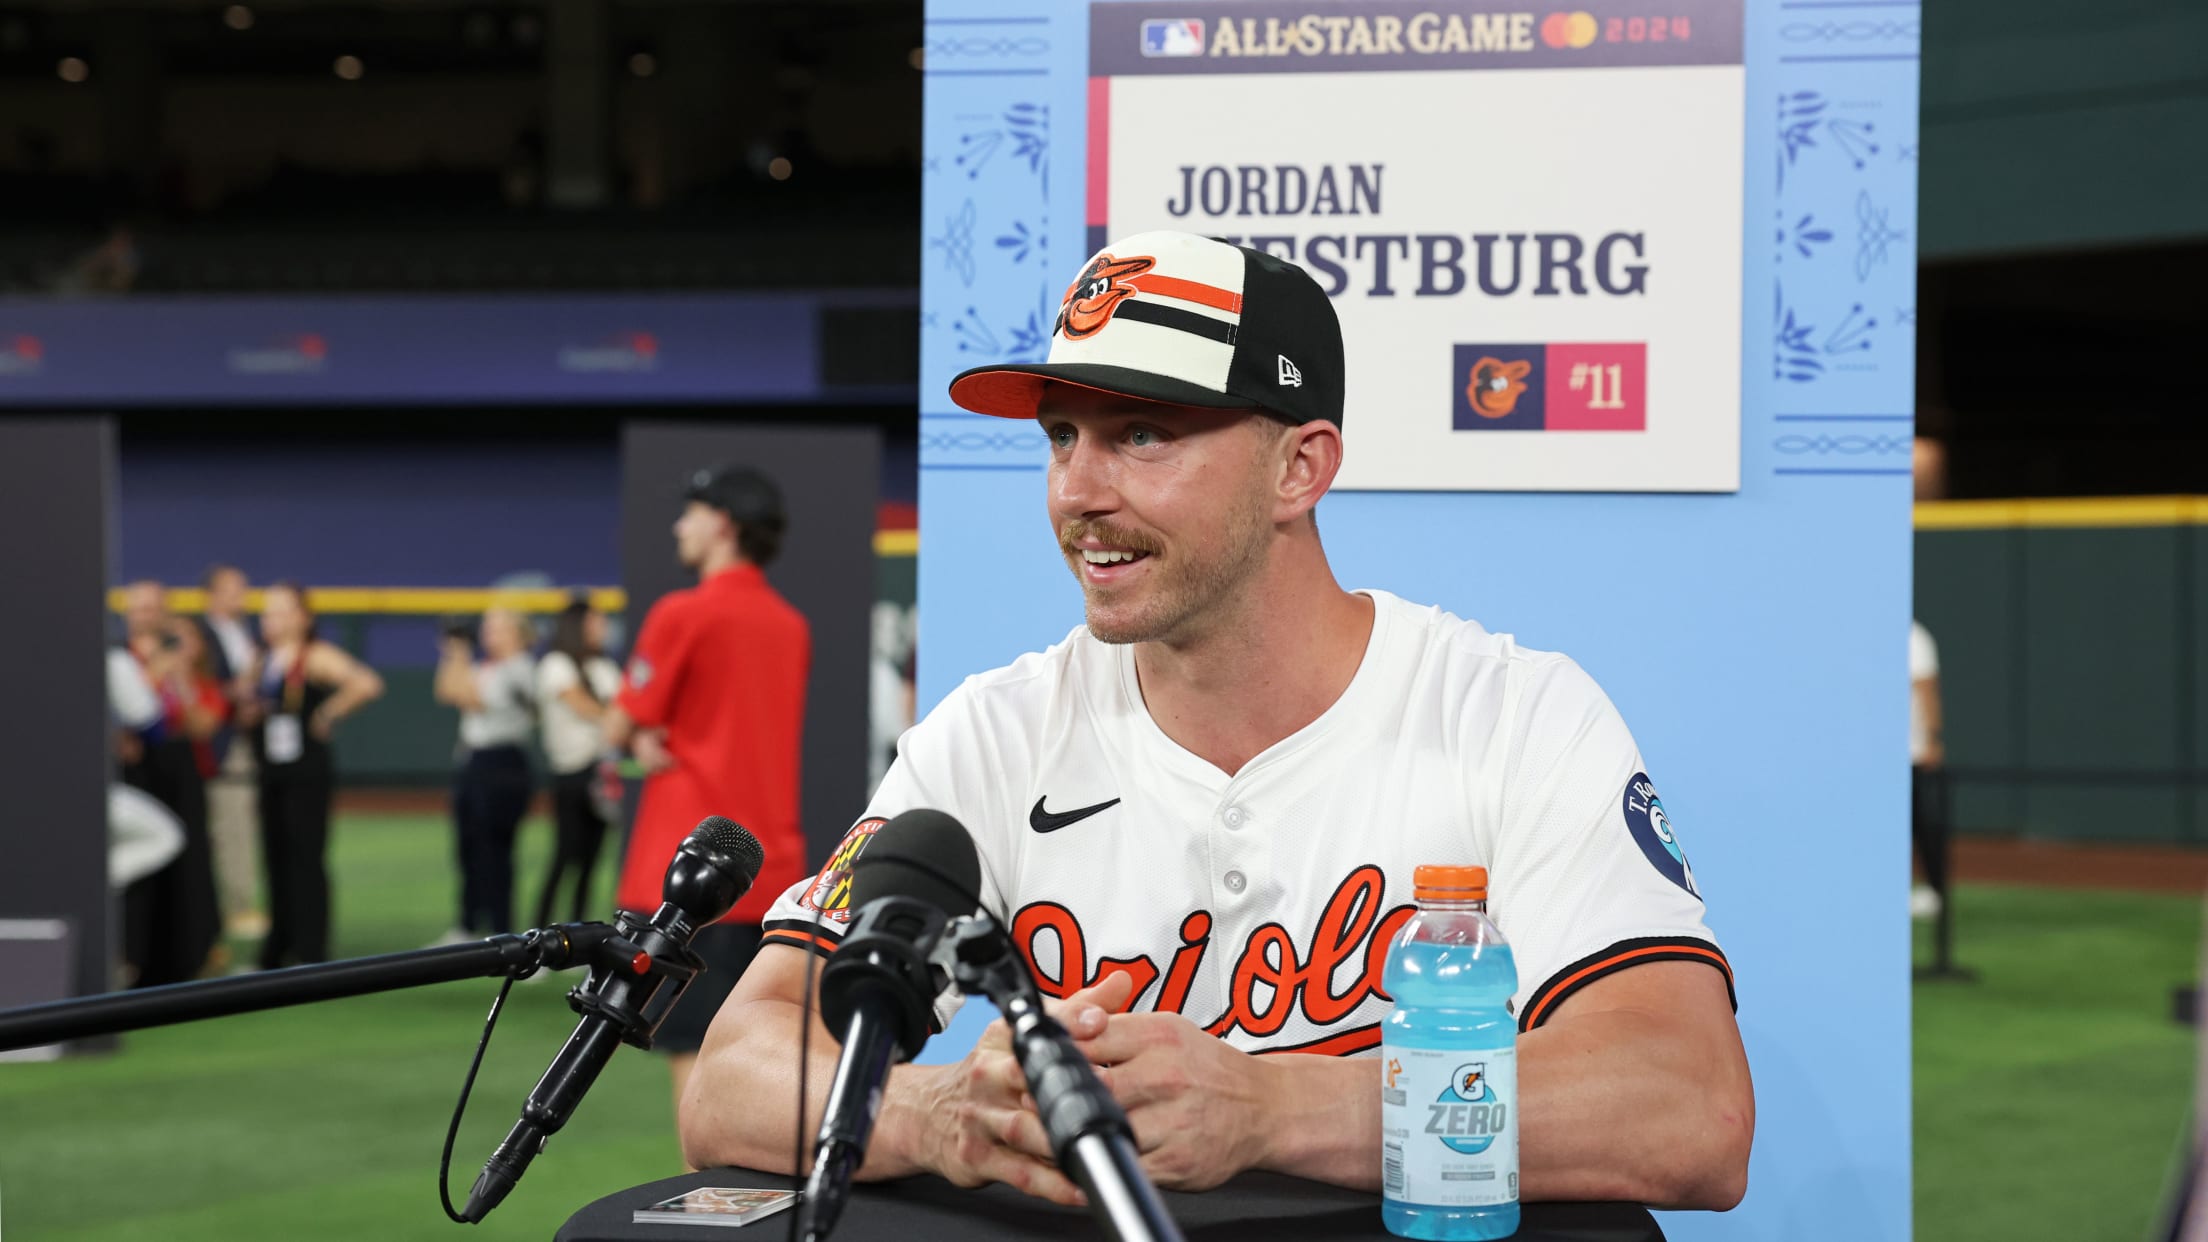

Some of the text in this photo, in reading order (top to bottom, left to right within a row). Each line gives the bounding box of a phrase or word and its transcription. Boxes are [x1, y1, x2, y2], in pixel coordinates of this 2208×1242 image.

[1406, 12, 1535, 53] GAME
[1605, 16, 1691, 42] 2024
[1167, 164, 1385, 217] JORDAN
[1226, 232, 1650, 298] STBURG
[1569, 363, 1626, 410] #11
[1424, 1103, 1506, 1135] ZERO
